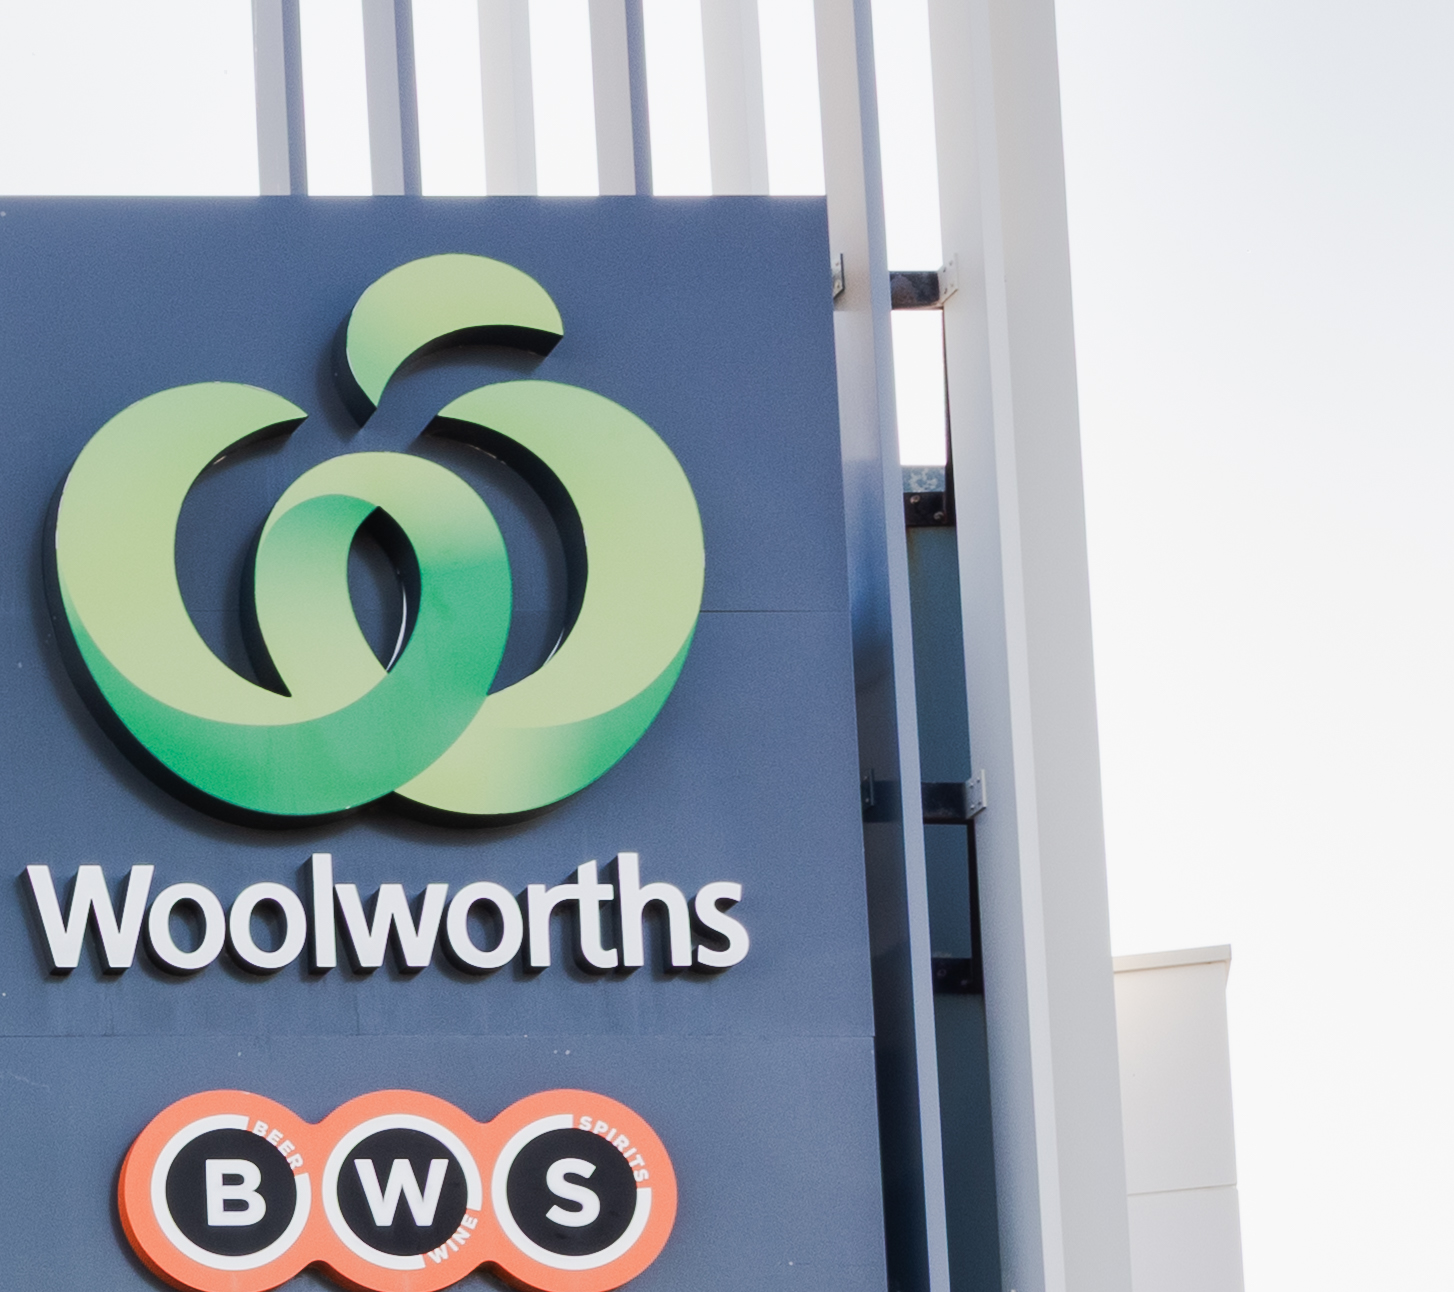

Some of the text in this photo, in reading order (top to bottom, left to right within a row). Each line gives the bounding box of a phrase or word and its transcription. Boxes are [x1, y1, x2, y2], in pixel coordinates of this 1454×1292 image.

[26, 852, 750, 970] Woolworths
[252, 1119, 304, 1171] BEER
[578, 1115, 649, 1182] SPIRITS
[426, 1213, 478, 1264] WINE
